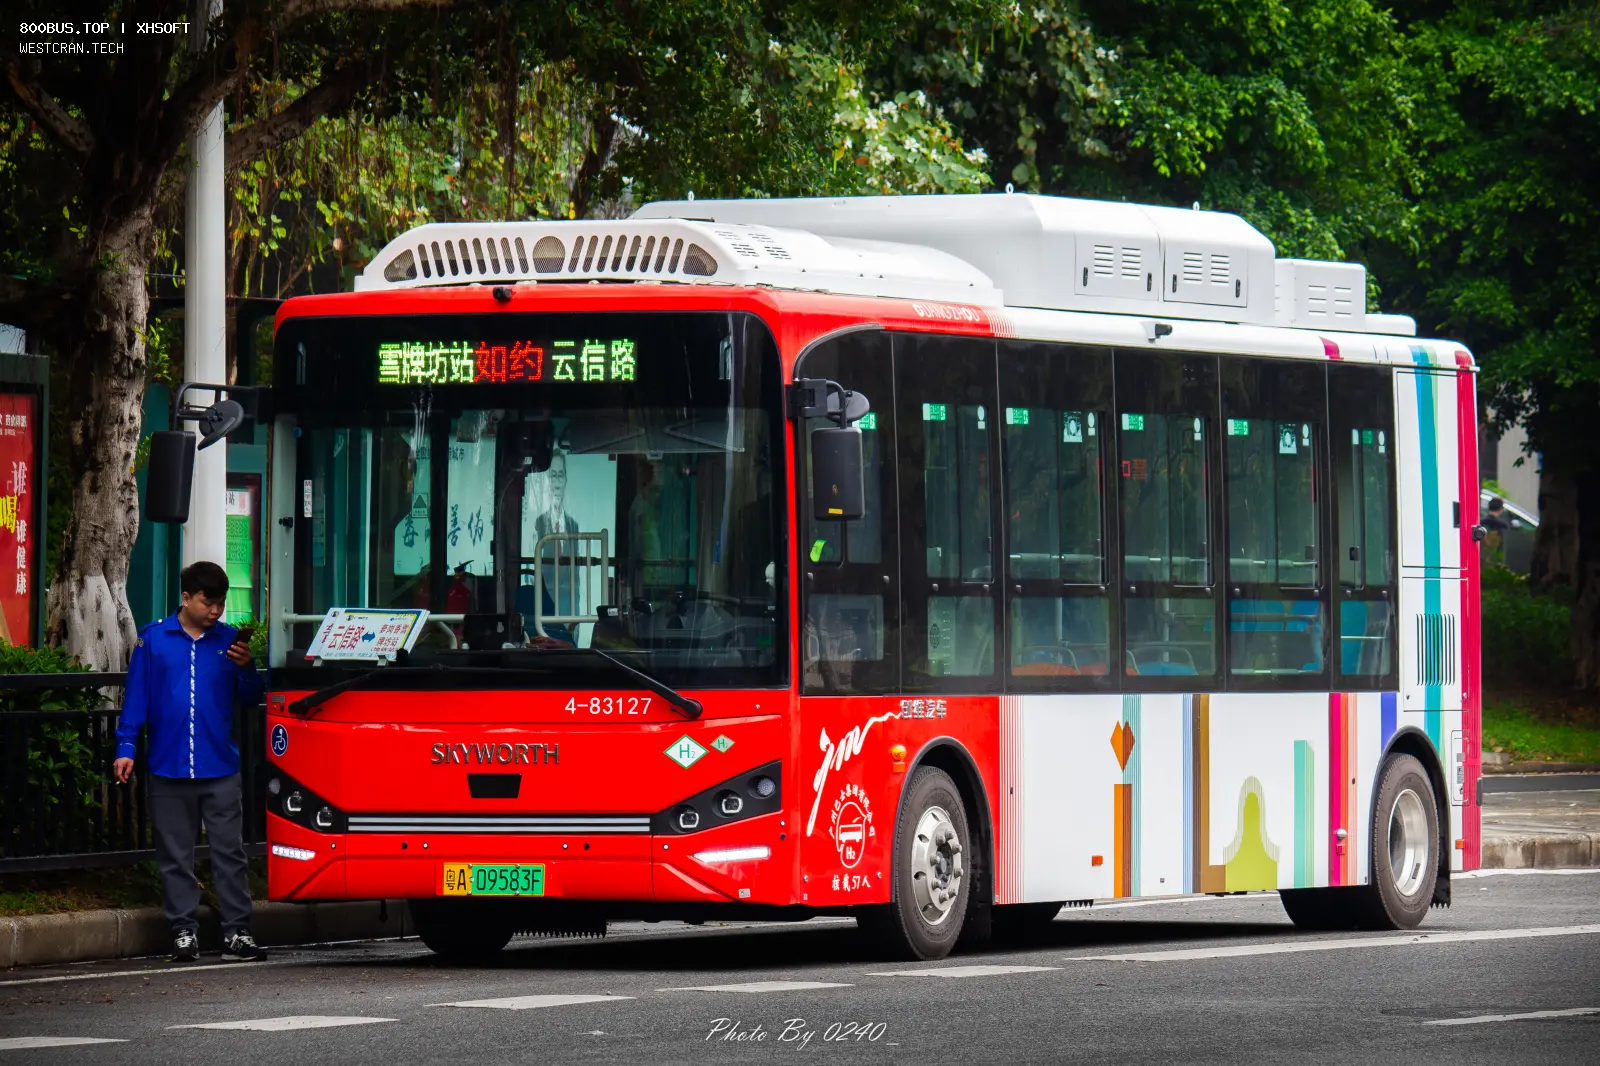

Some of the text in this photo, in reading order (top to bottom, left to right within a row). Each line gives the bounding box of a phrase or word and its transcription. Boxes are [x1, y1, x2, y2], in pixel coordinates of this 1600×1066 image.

[912, 303, 980, 322] GUANGZHOU
[551, 339, 636, 382] 云信路
[327, 625, 366, 650] 云信路
[564, 696, 652, 715] 4-83127
[430, 743, 560, 765] SKYWORTH
